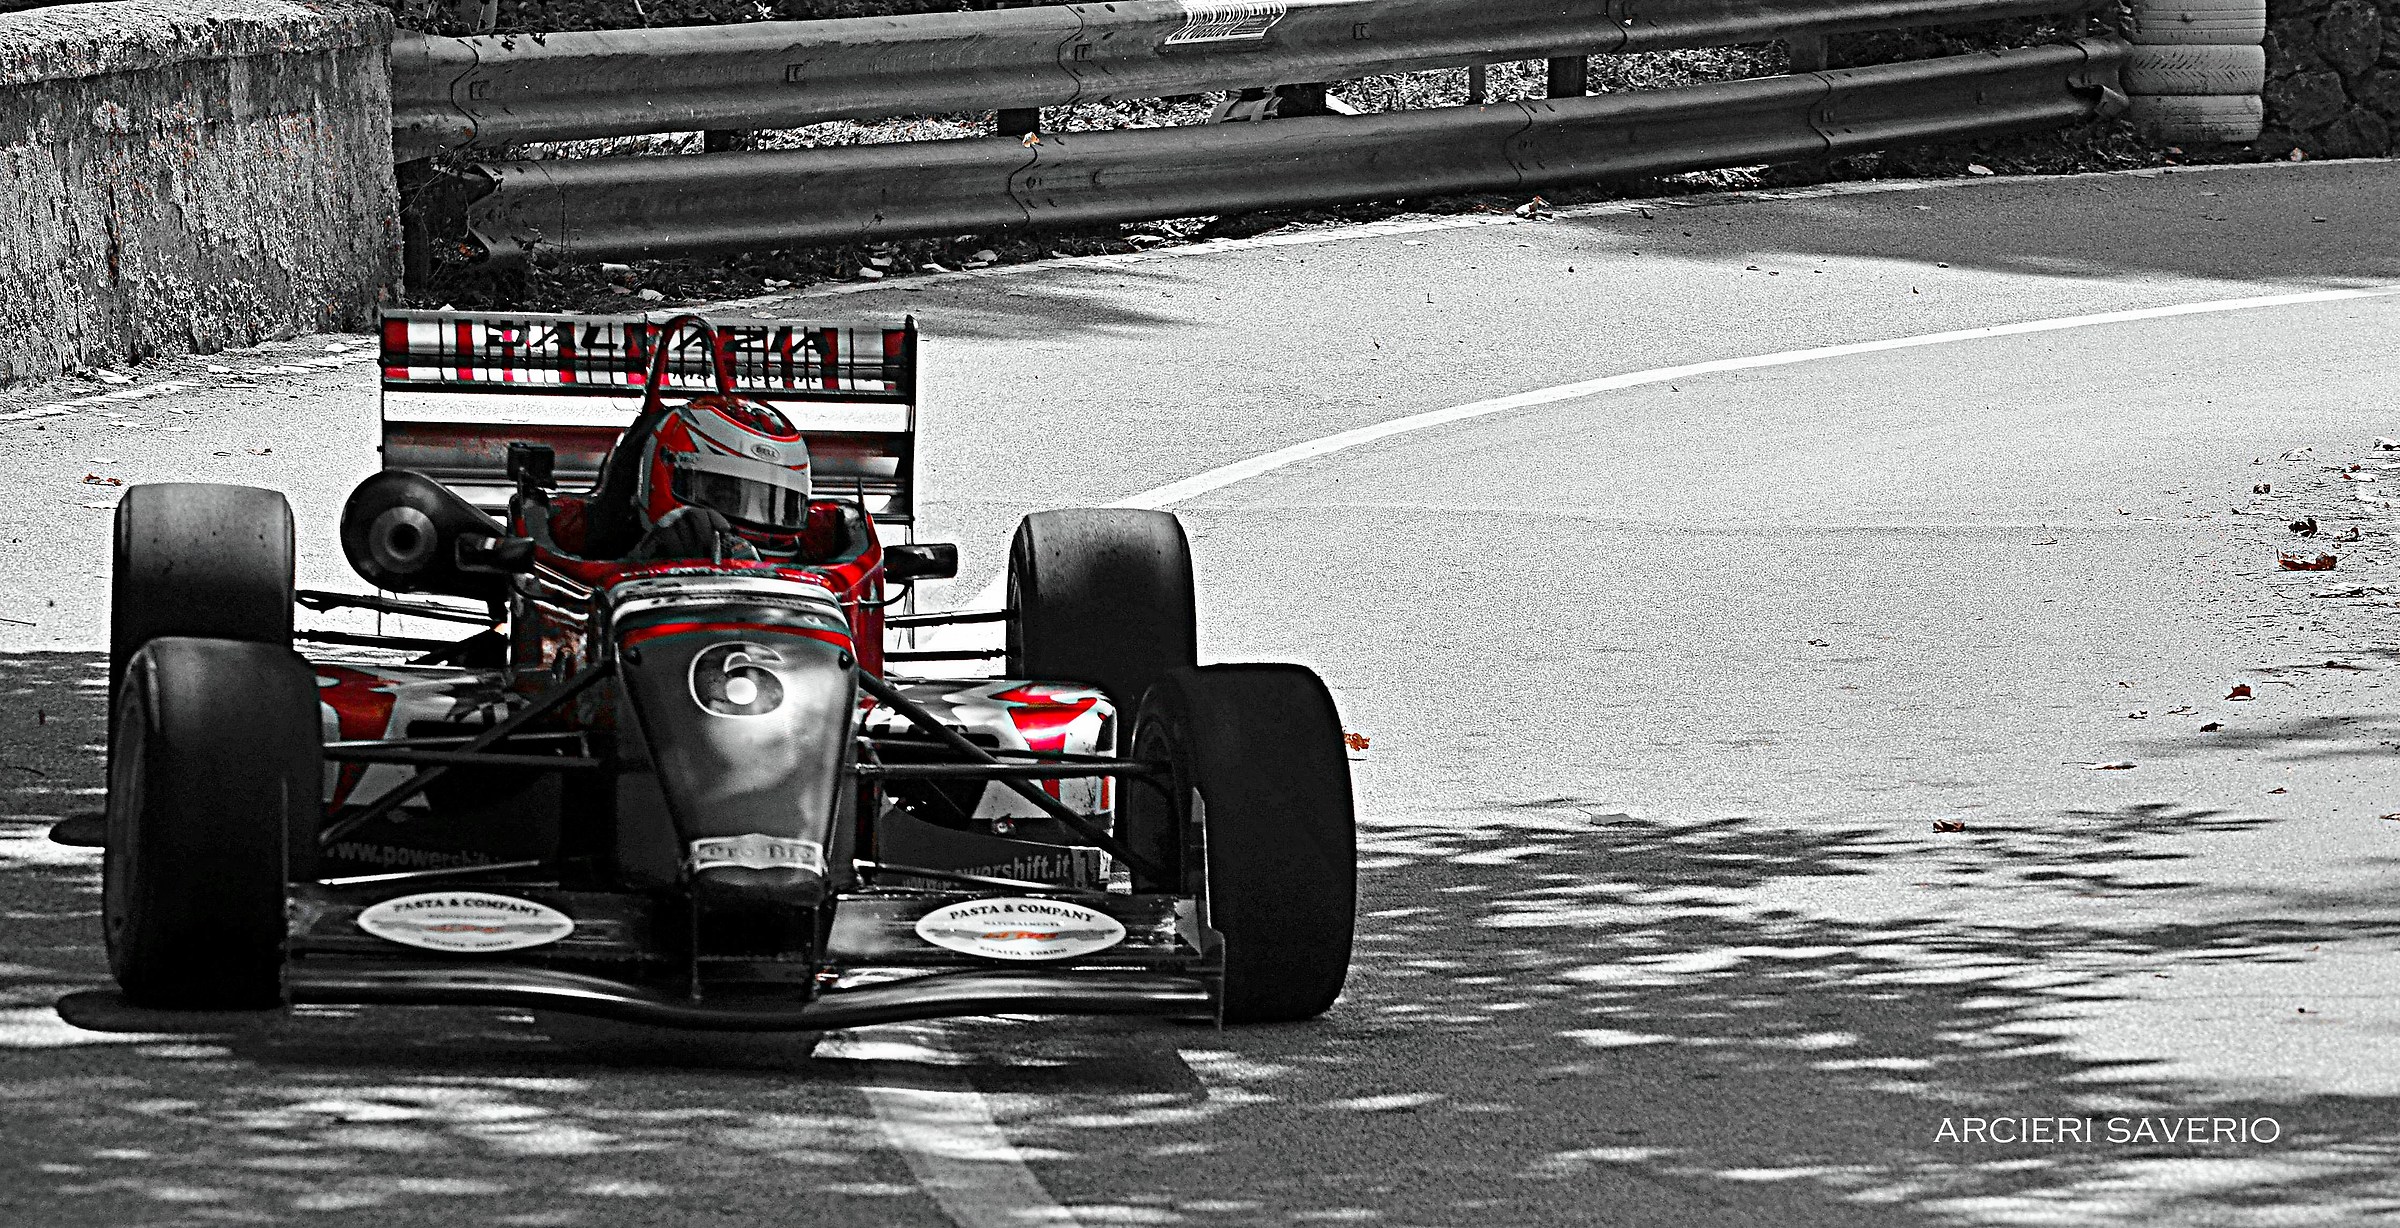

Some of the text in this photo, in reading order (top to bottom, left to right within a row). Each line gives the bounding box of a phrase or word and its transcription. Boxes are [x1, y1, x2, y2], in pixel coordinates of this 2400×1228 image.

[688, 641, 784, 718] 6
[394, 899, 445, 912] PASTA
[450, 899, 459, 907] &
[464, 899, 542, 917] COMPANY
[949, 905, 1000, 920] PASTA
[1018, 904, 1095, 922] COMPANY
